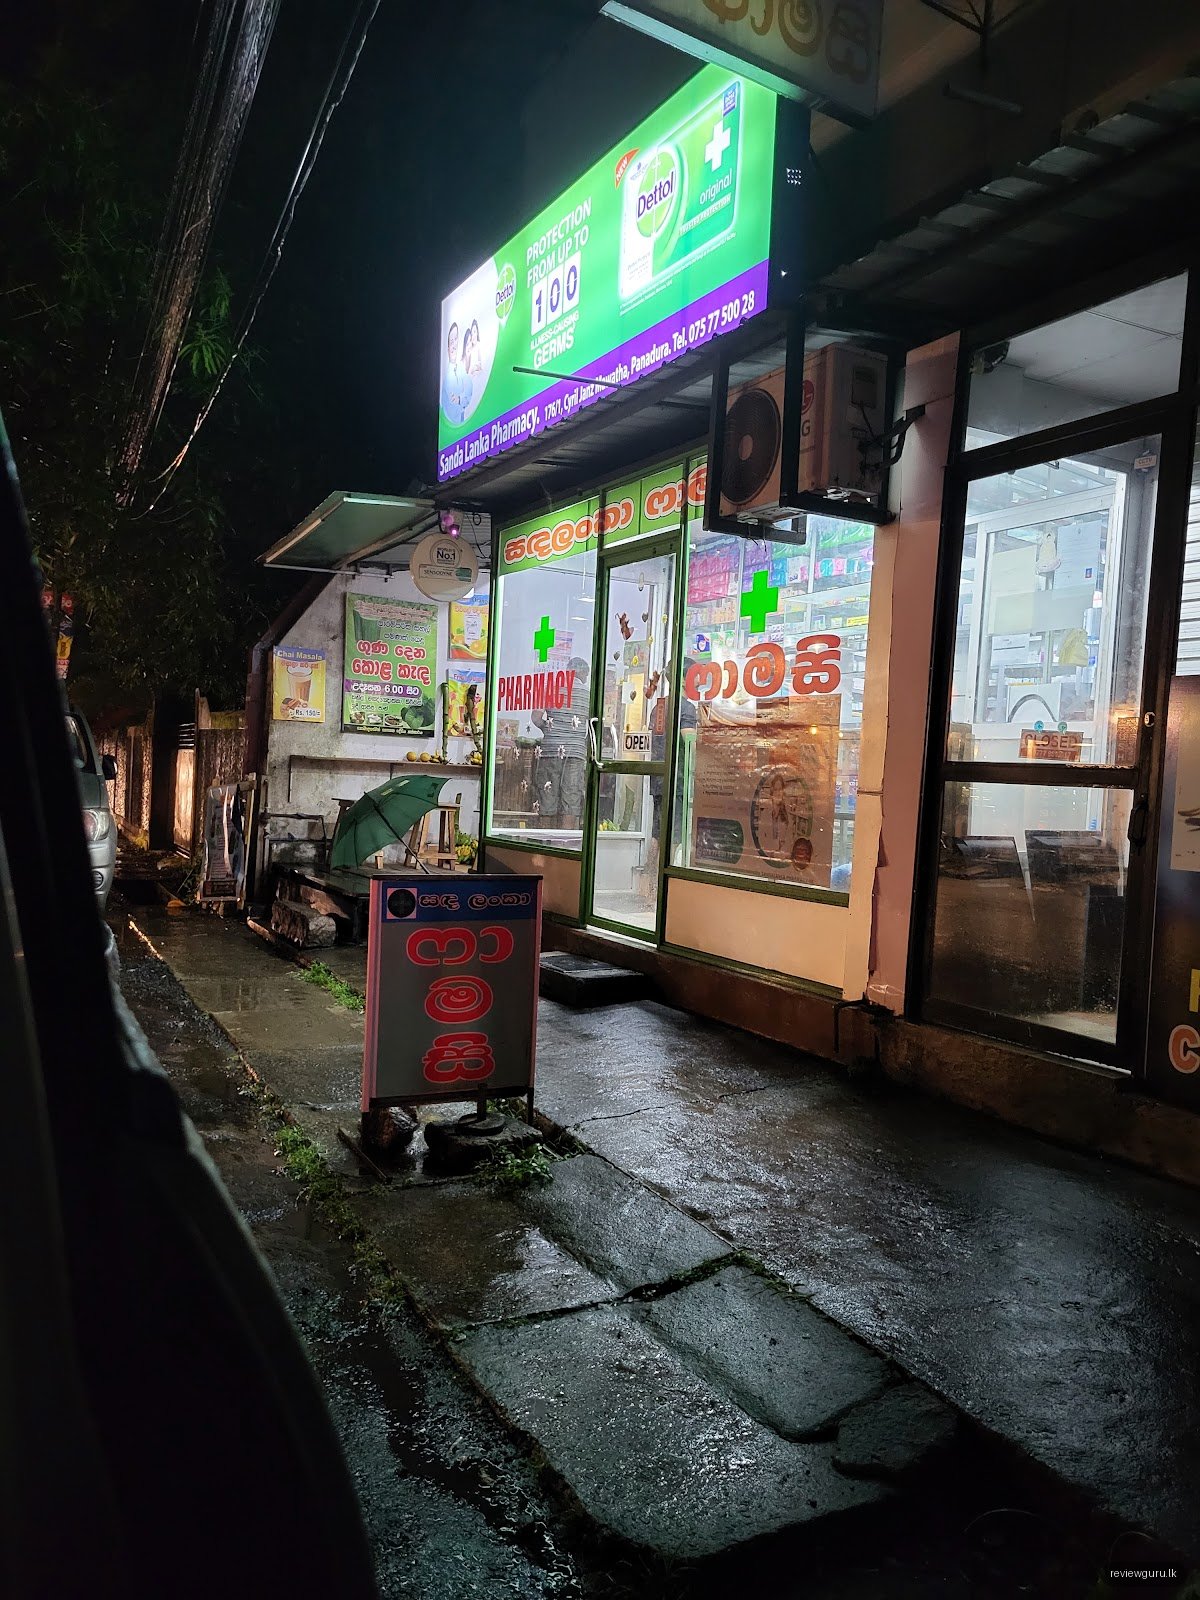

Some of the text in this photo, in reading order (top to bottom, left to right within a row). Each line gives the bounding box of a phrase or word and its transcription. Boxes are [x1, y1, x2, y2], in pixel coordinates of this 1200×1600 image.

[616, 157, 628, 181] NEW
[637, 171, 674, 218] Dettol
[700, 168, 732, 204] original
[526, 197, 592, 266] PROTECTION
[527, 225, 589, 289] FROM UP TO
[496, 280, 515, 306] Dettol
[535, 265, 577, 323] 100
[440, 445, 463, 476] Sanda
[465, 431, 489, 462] Lanka
[491, 406, 540, 448] Pharmacy.
[545, 398, 563, 421] 176/1,
[563, 387, 578, 414] Cyril
[578, 384, 595, 403] Janz
[631, 340, 671, 374] Panadura.
[672, 326, 687, 352] Tel.
[689, 319, 706, 343] 075
[707, 310, 720, 333] 77
[721, 299, 740, 326] 500
[742, 290, 754, 315] 28
[437, 550, 455, 560] No.1
[277, 650, 322, 660] Chai Masala
[358, 640, 425, 660] ගුණ දෙන
[498, 670, 575, 711] PHARMACY
[625, 735, 650, 751] OPEN
[1025, 734, 1077, 749] CLOSED
